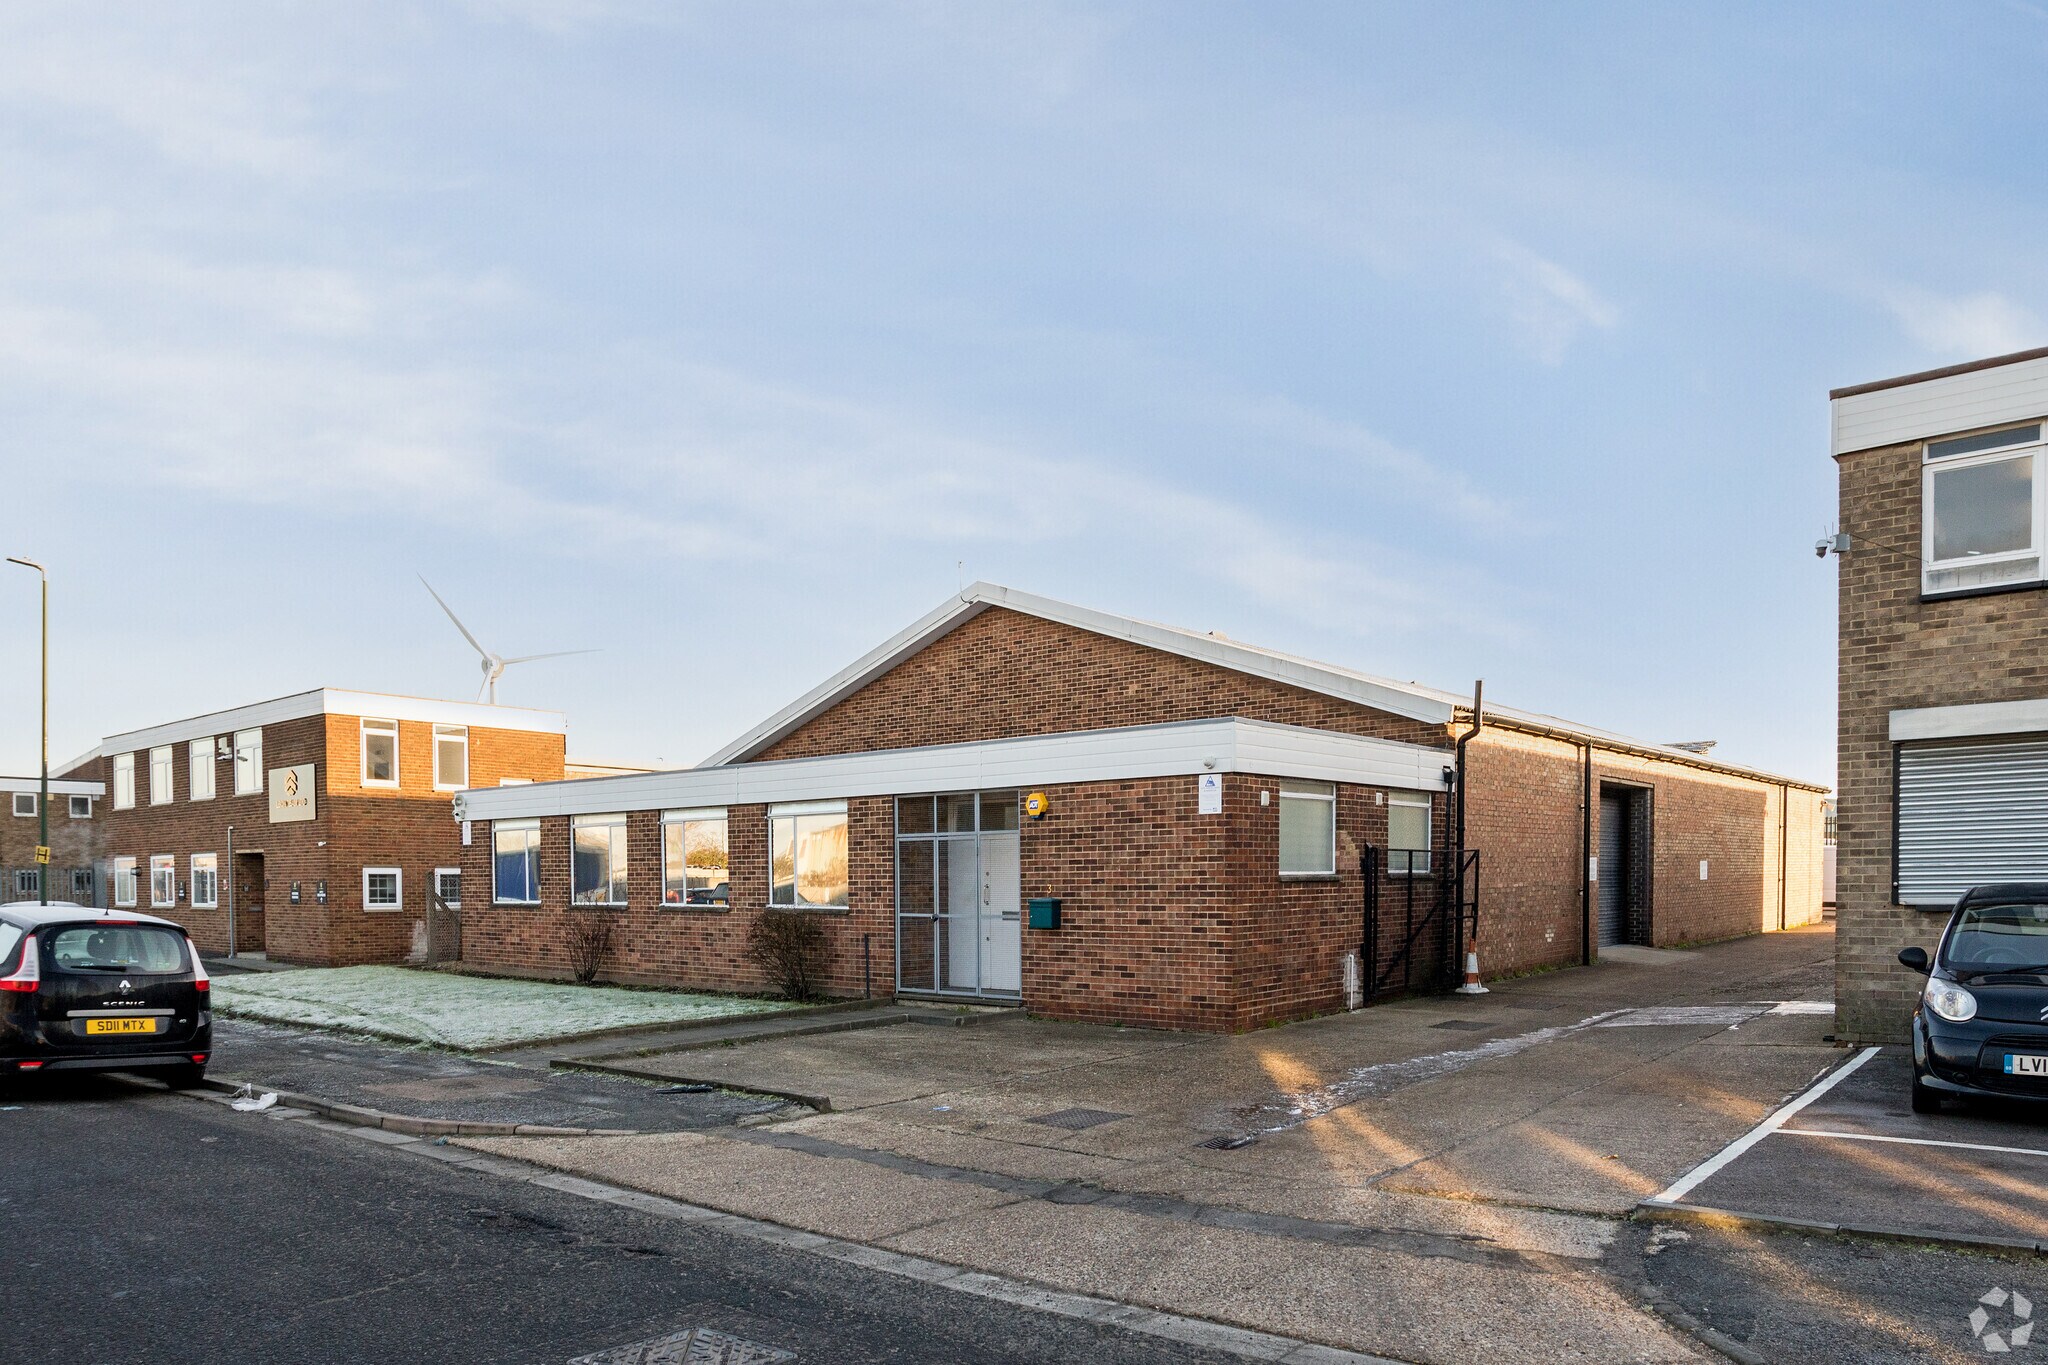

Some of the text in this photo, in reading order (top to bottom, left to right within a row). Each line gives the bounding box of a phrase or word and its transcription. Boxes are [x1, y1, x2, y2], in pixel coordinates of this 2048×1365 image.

[37, 848, 47, 861] H
[97, 1020, 146, 1031] SD11 MTX
